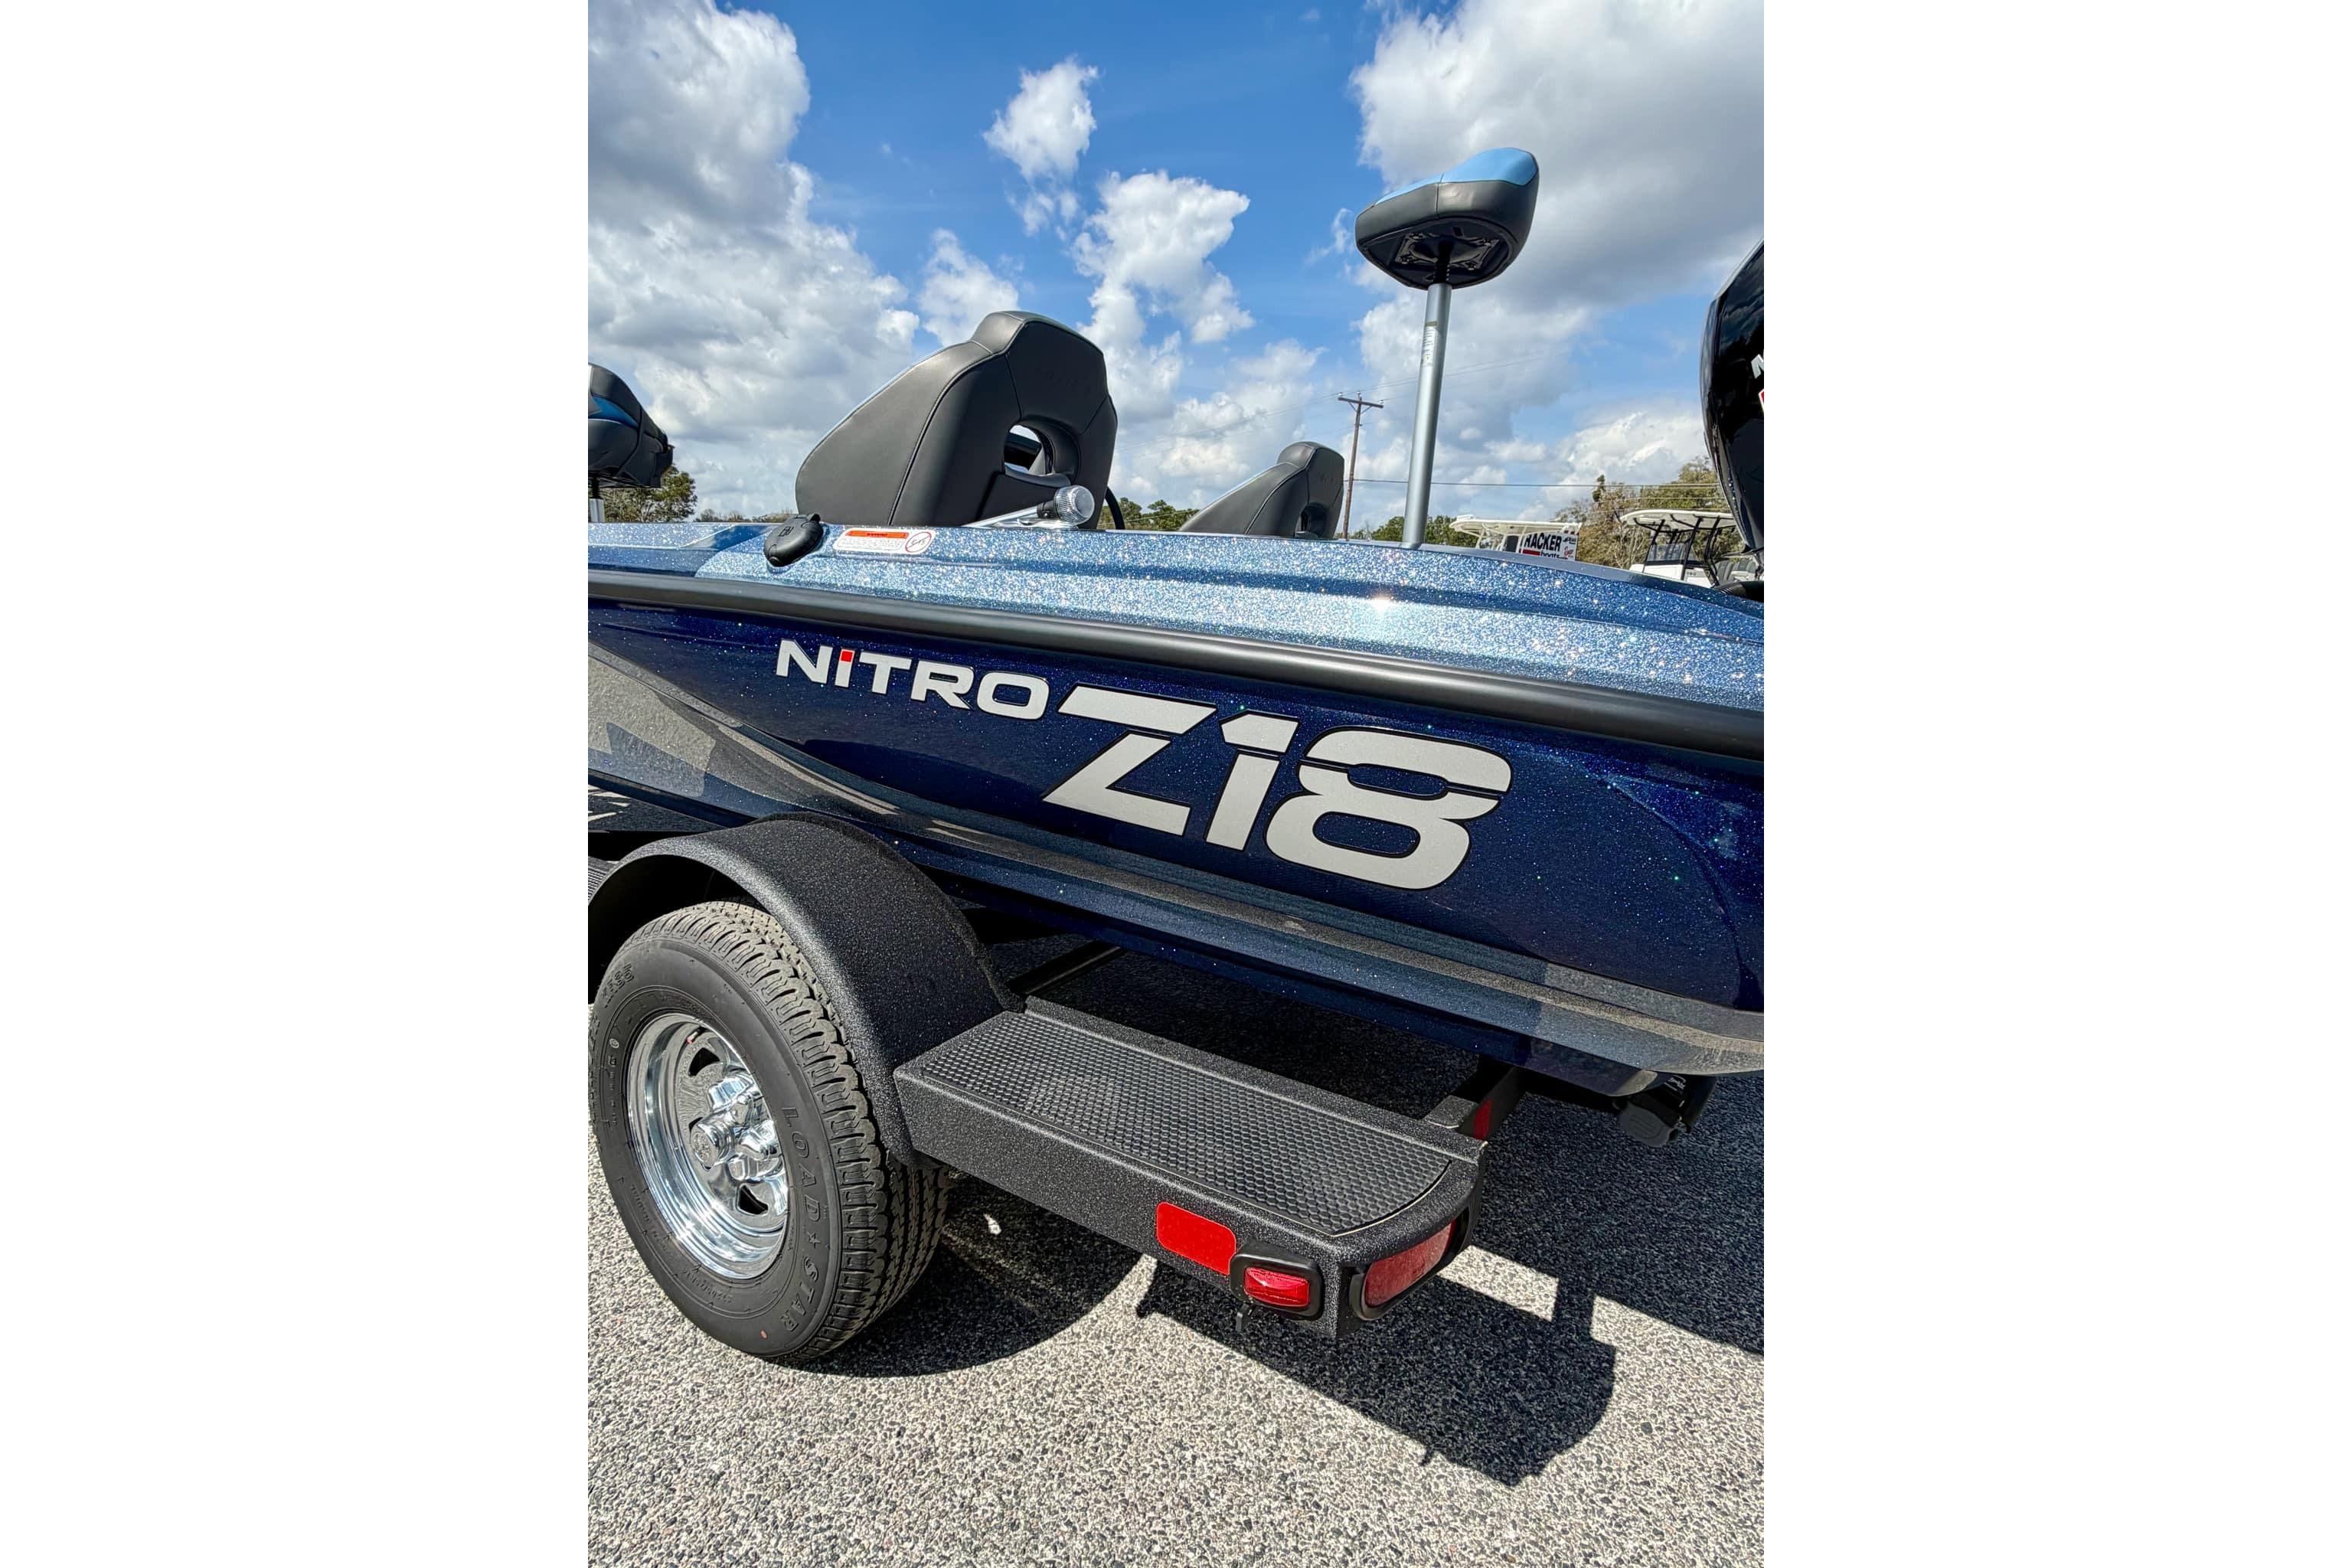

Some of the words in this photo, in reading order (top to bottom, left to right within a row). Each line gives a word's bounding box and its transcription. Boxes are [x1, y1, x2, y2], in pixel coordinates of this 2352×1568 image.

[776, 638, 1050, 720] NITRO
[1042, 682, 1512, 890] Z18
[781, 1107, 821, 1222] LOAD
[780, 1256, 819, 1332] STAR
